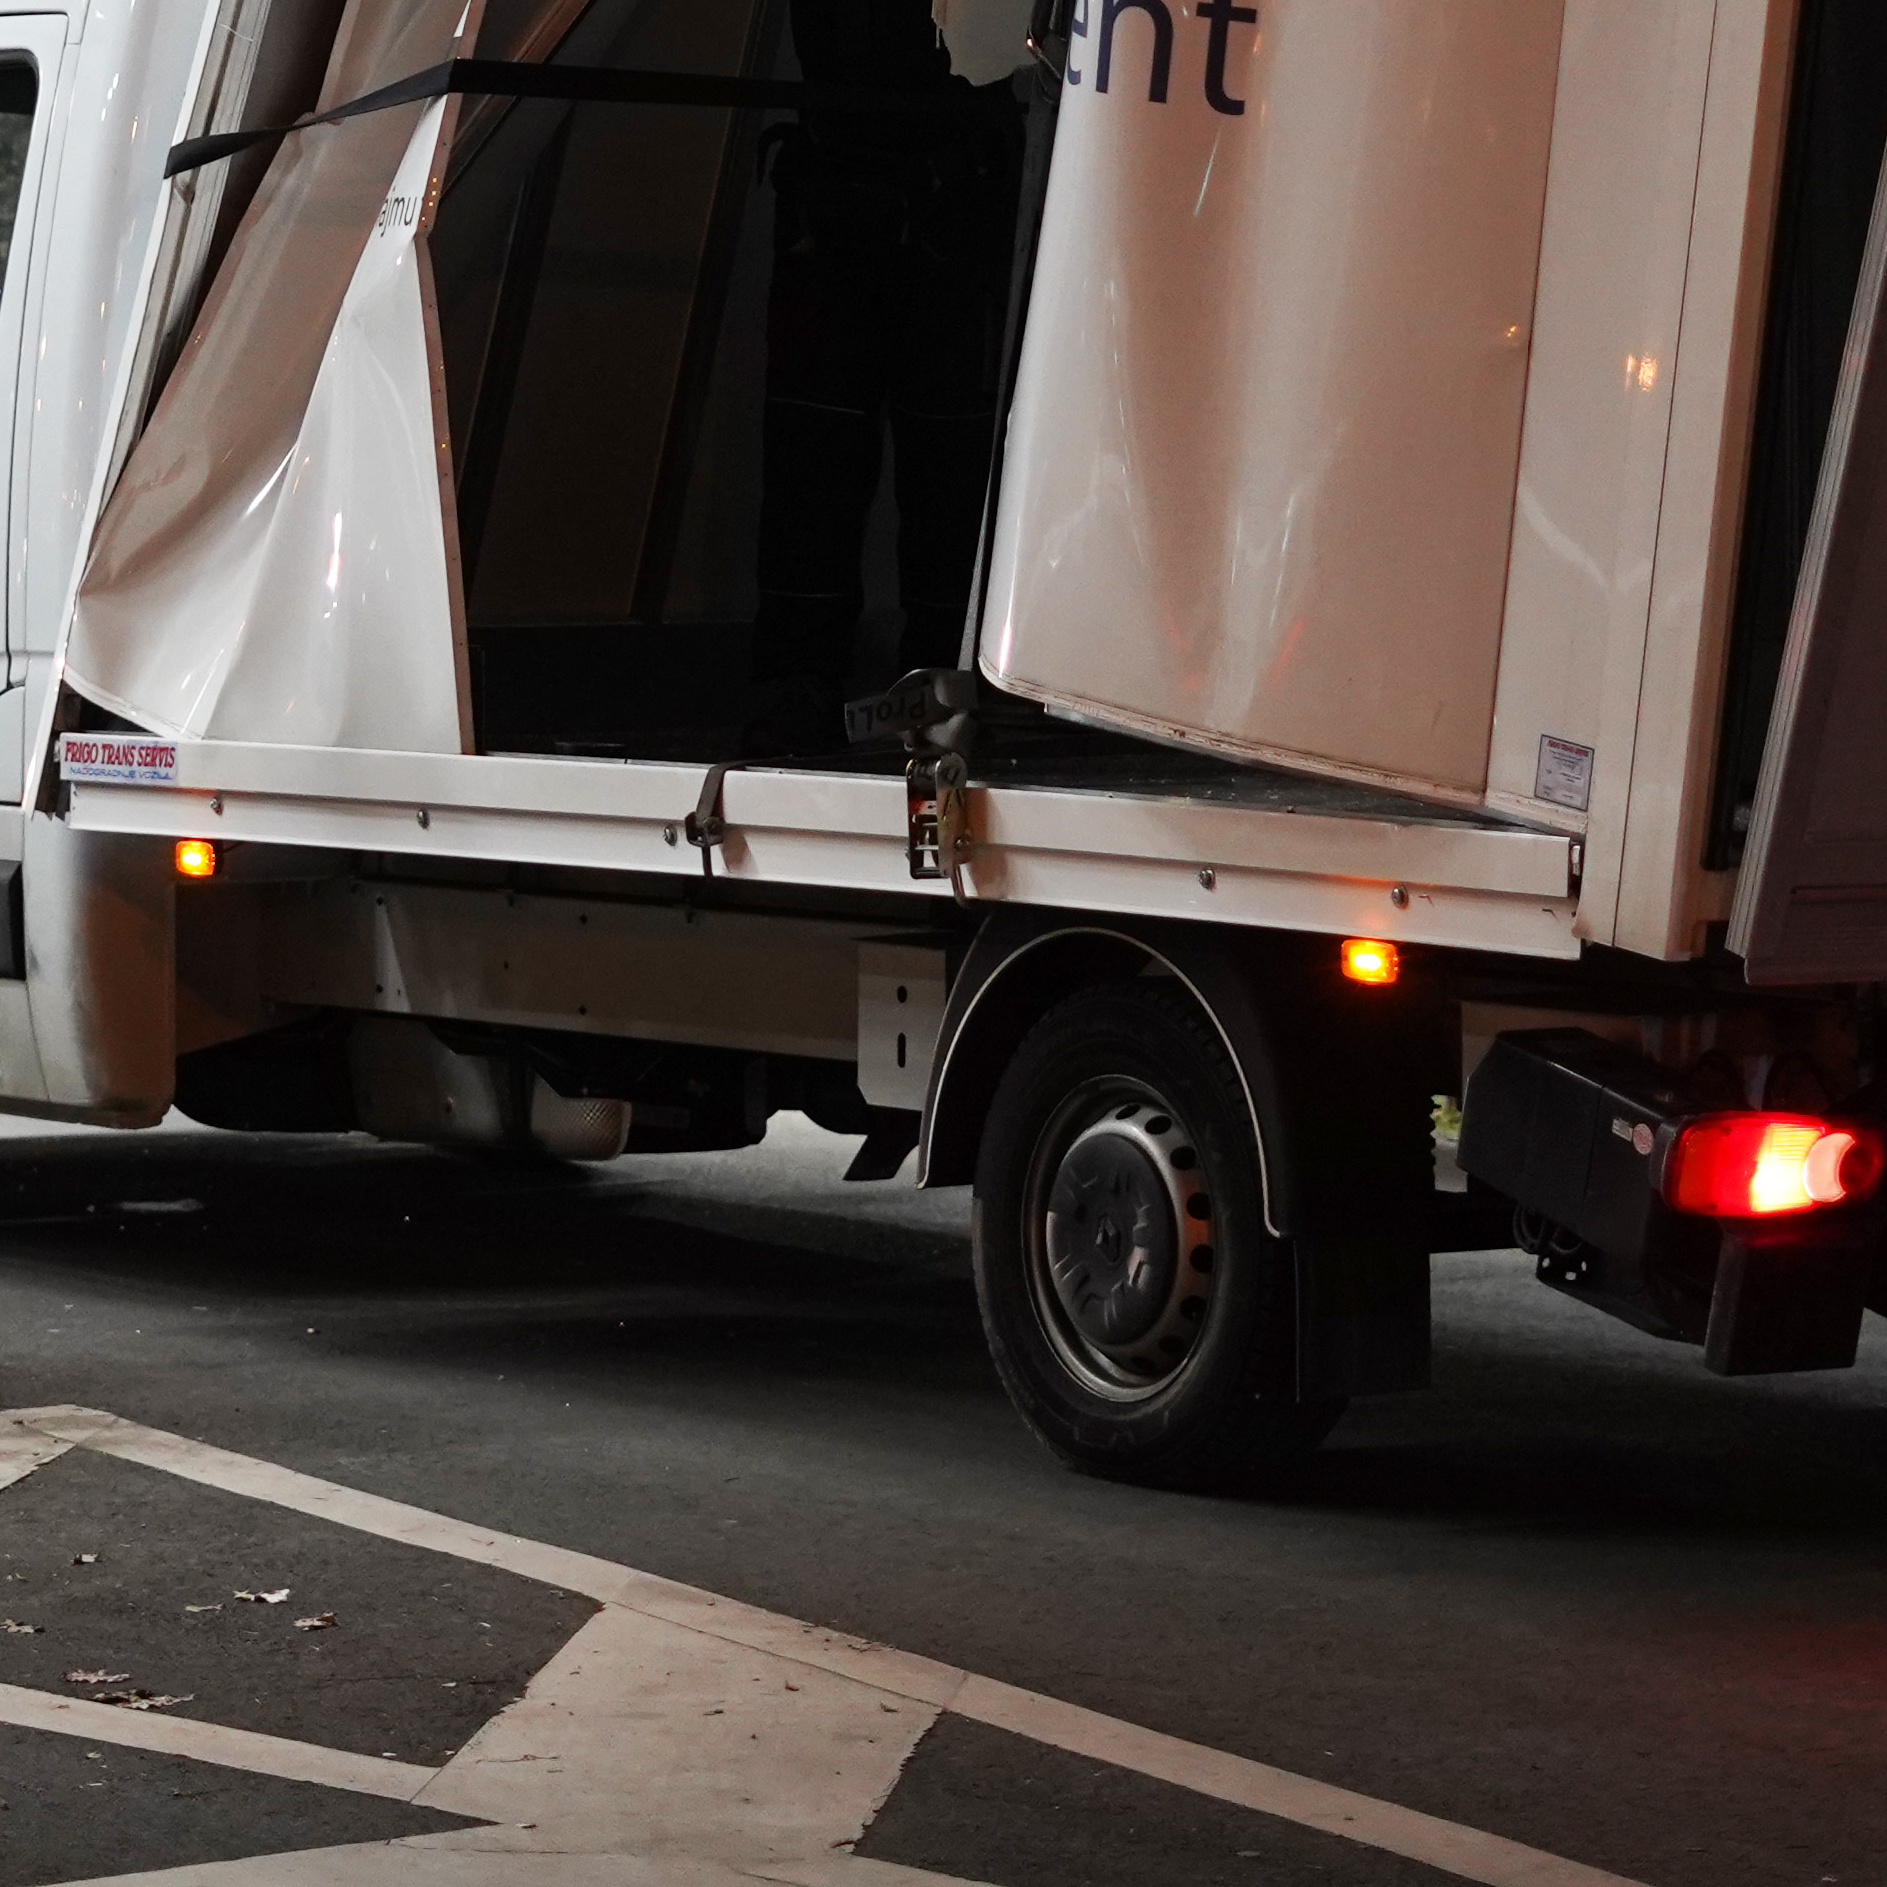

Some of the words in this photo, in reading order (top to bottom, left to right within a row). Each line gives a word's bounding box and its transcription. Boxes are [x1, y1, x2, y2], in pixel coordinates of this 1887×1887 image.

[64, 741, 99, 764] FRIGO
[101, 743, 136, 766] TRANS
[137, 746, 176, 768] SERVIS
